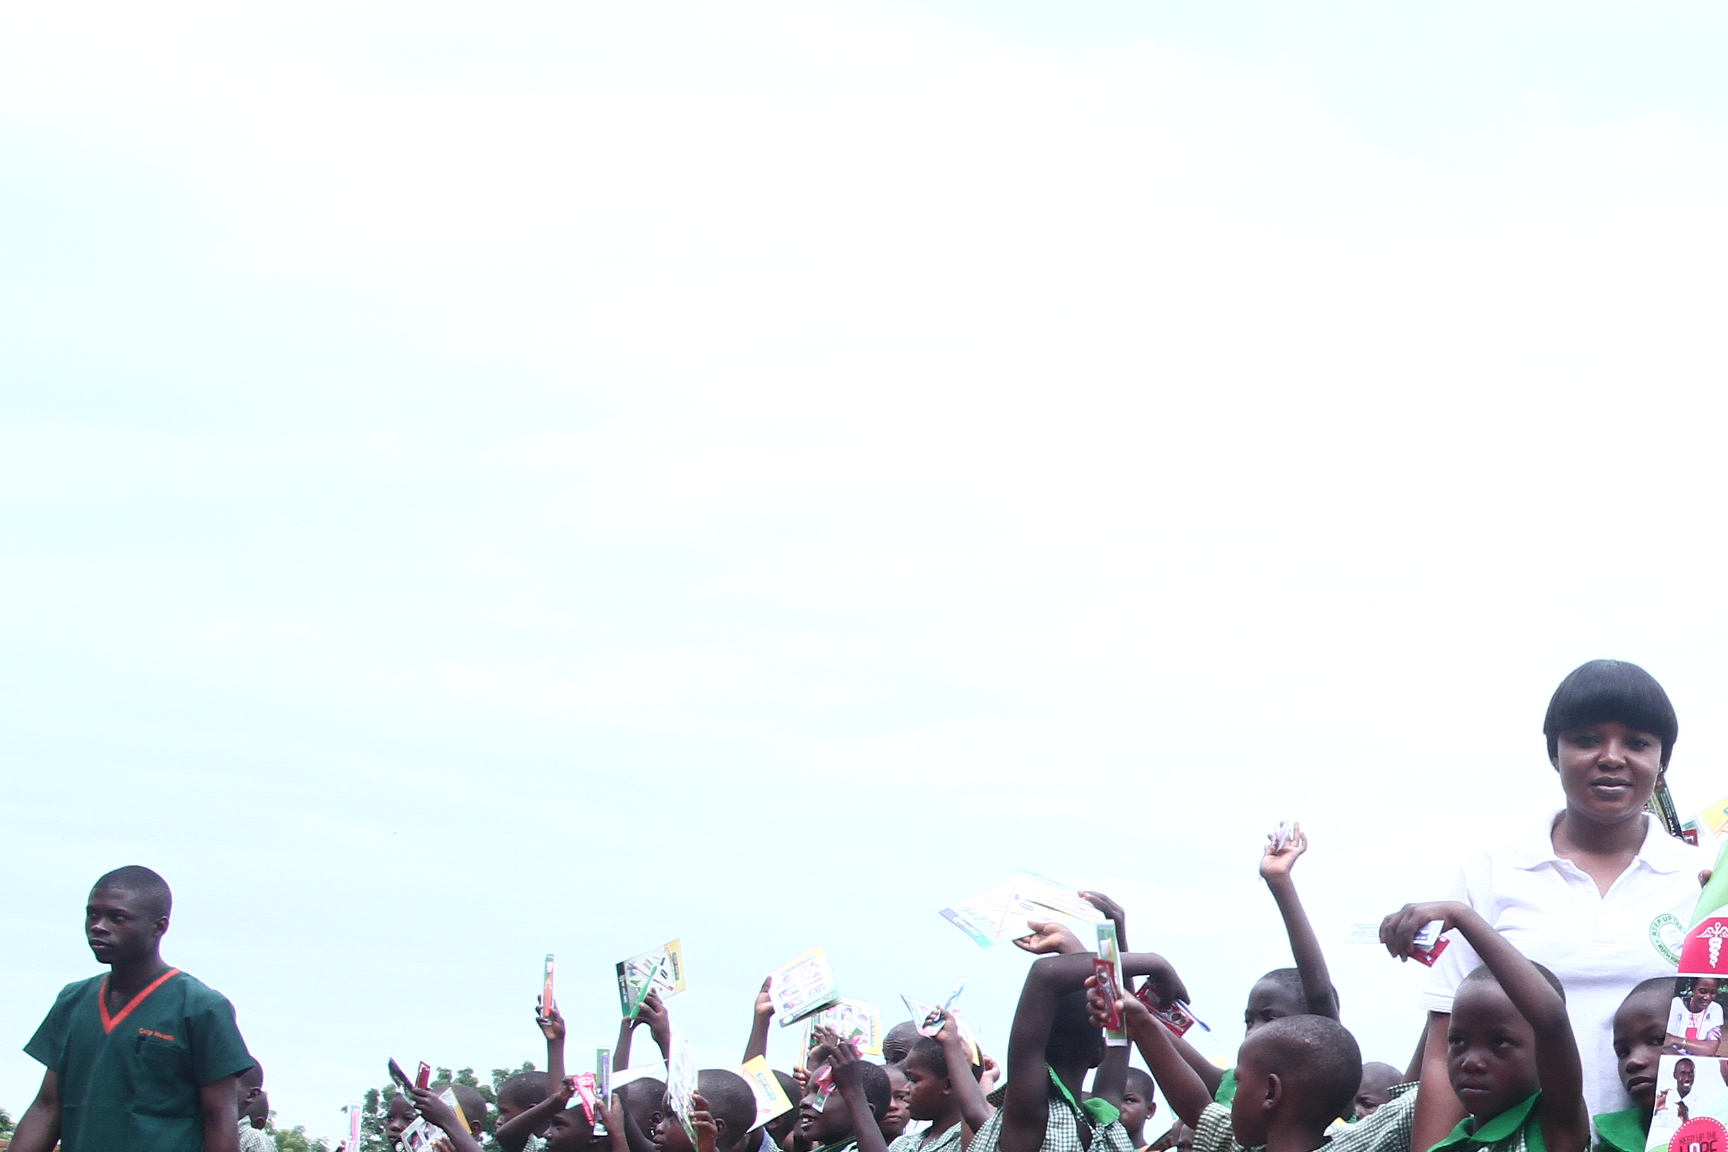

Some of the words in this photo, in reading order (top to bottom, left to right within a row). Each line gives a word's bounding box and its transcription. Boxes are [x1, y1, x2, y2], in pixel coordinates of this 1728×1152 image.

[1651, 919, 1660, 936] KEEP
[1657, 943, 1670, 958] KUTH
[1678, 1135, 1694, 1144] KEEP
[1696, 1133, 1704, 1141] UP
[1706, 1131, 1717, 1140] THE
